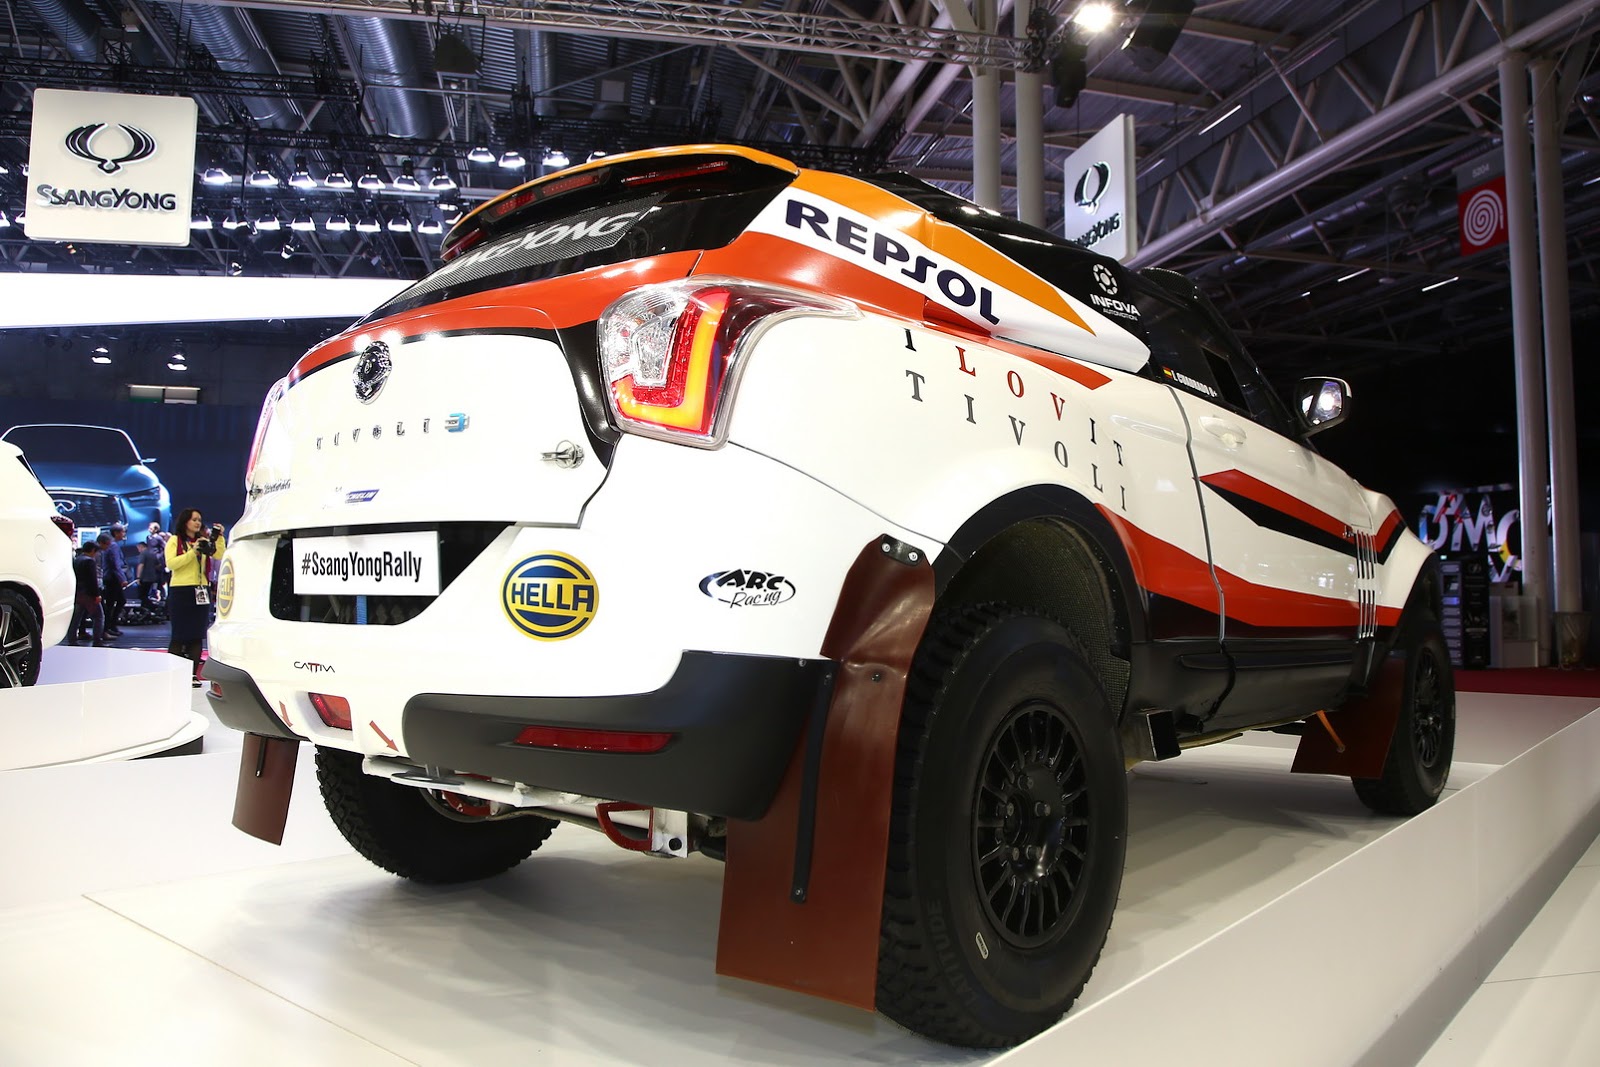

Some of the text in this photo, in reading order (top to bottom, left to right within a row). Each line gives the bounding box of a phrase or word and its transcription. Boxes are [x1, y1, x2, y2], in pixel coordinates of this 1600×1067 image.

[785, 199, 1000, 325] REPSOL
[1090, 294, 1141, 316] INFOVA
[905, 369, 1127, 511] TIVOLI
[301, 551, 422, 583] #SsangYongRally
[511, 582, 594, 612] HELLA
